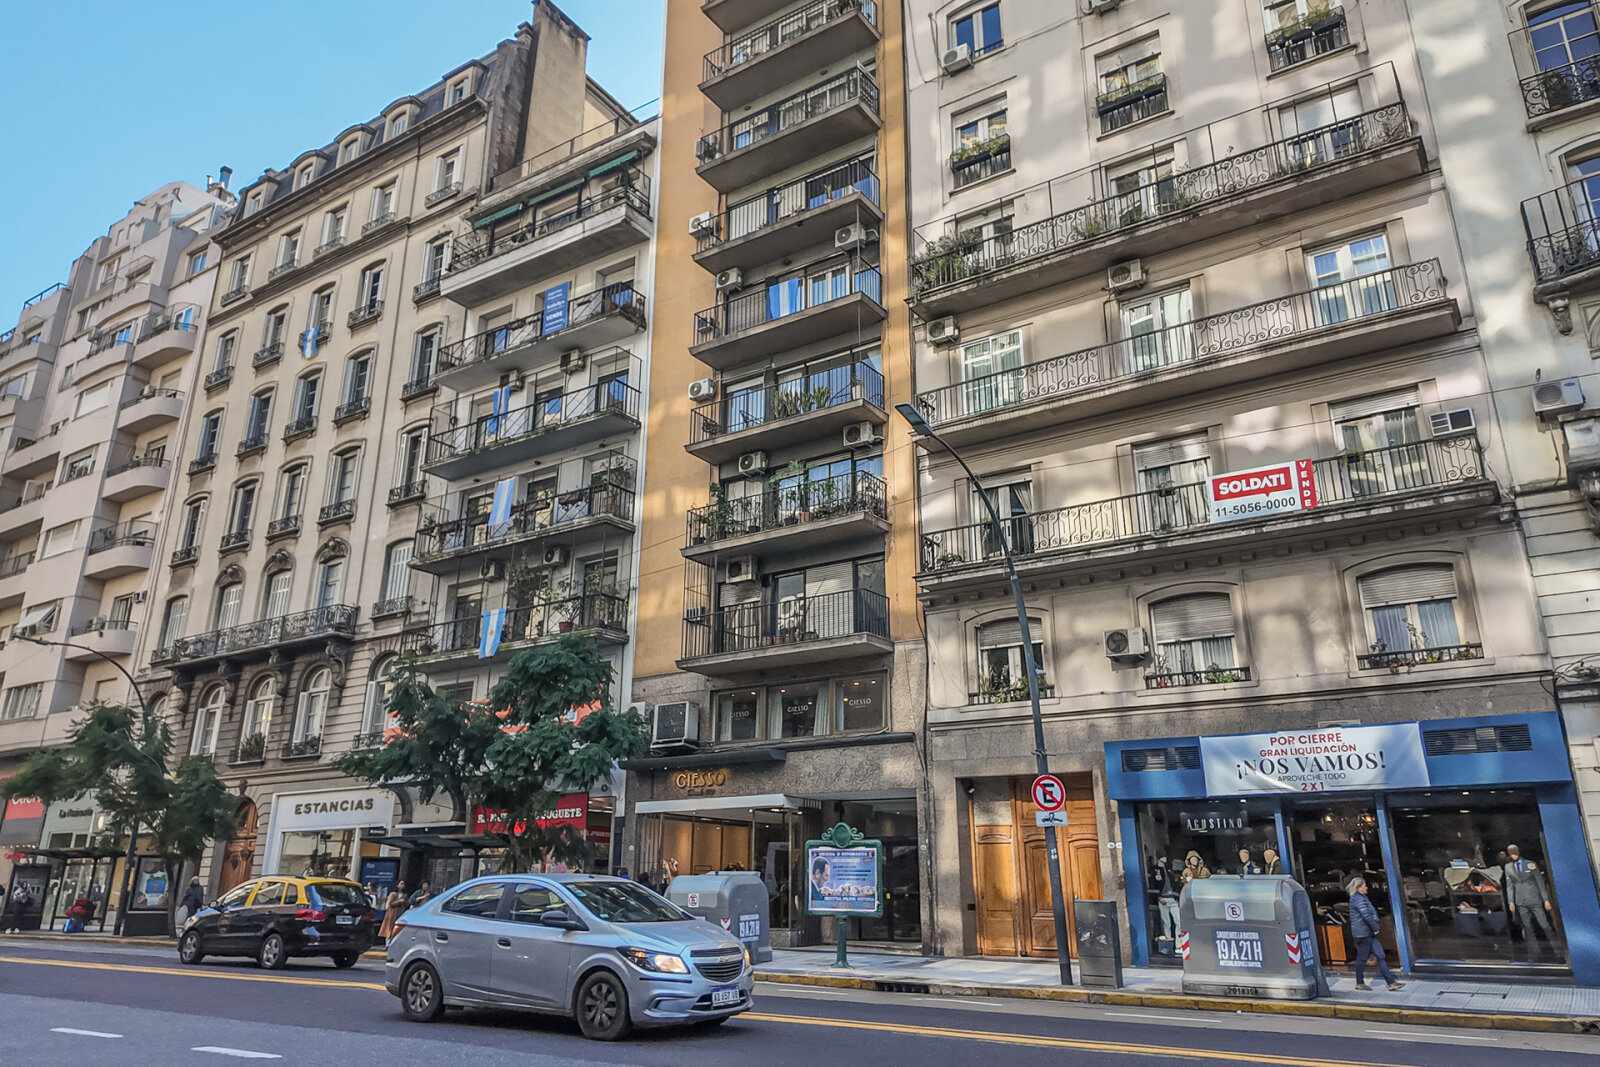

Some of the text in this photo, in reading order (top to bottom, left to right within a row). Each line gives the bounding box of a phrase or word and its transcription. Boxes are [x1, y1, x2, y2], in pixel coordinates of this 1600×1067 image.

[1218, 473, 1286, 495] SOLDATI
[1299, 460, 1312, 507] VENDE
[1215, 496, 1296, 517] 11-5056-0000
[1269, 732, 1343, 746] POR CIERRE
[1259, 742, 1357, 758] GRAN LIQUIDACIÓN
[1294, 751, 1387, 773] VAMOS!
[1277, 772, 1346, 782] APROVECHE TODO
[1041, 783, 1057, 803] E
[1301, 782, 1308, 791] 2
[1320, 782, 1325, 790] 1
[294, 798, 374, 815] ESTANCIAS
[1186, 817, 1243, 829] AGUSTINO
[1215, 939, 1263, 961] 19 A 21 H
